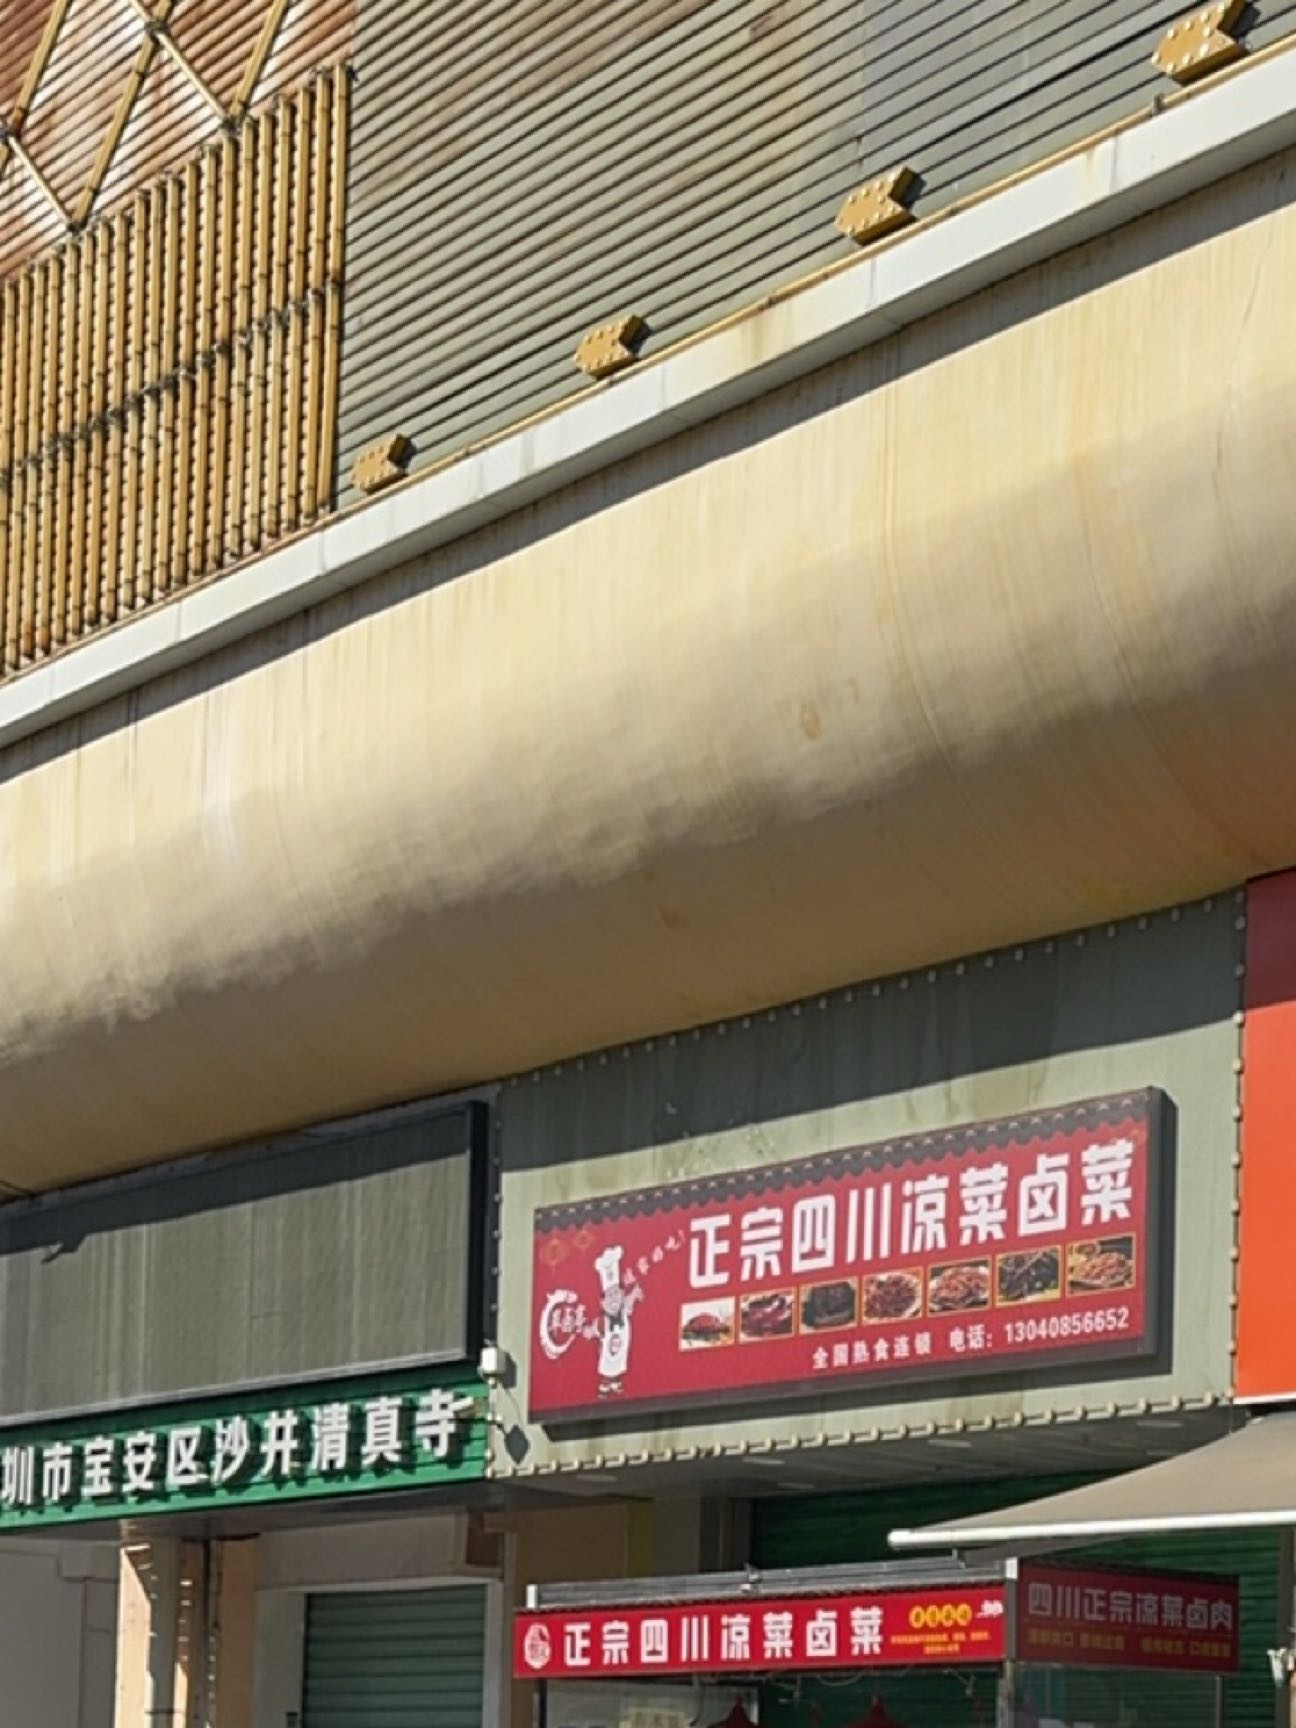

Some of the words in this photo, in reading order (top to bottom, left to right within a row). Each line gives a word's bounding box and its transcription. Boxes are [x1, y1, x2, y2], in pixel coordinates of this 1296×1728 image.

[688, 1137, 1135, 1289] 正宗四川凉菜卤菜
[812, 1331, 932, 1369] 全国熟食连锁
[0, 1388, 474, 1506] 圳市宝安区沙井清真寺
[563, 1605, 883, 1667] 正宗四川凉菜卤菜
[1028, 1582, 1234, 1631] 四川正宗凉菜卤肉
